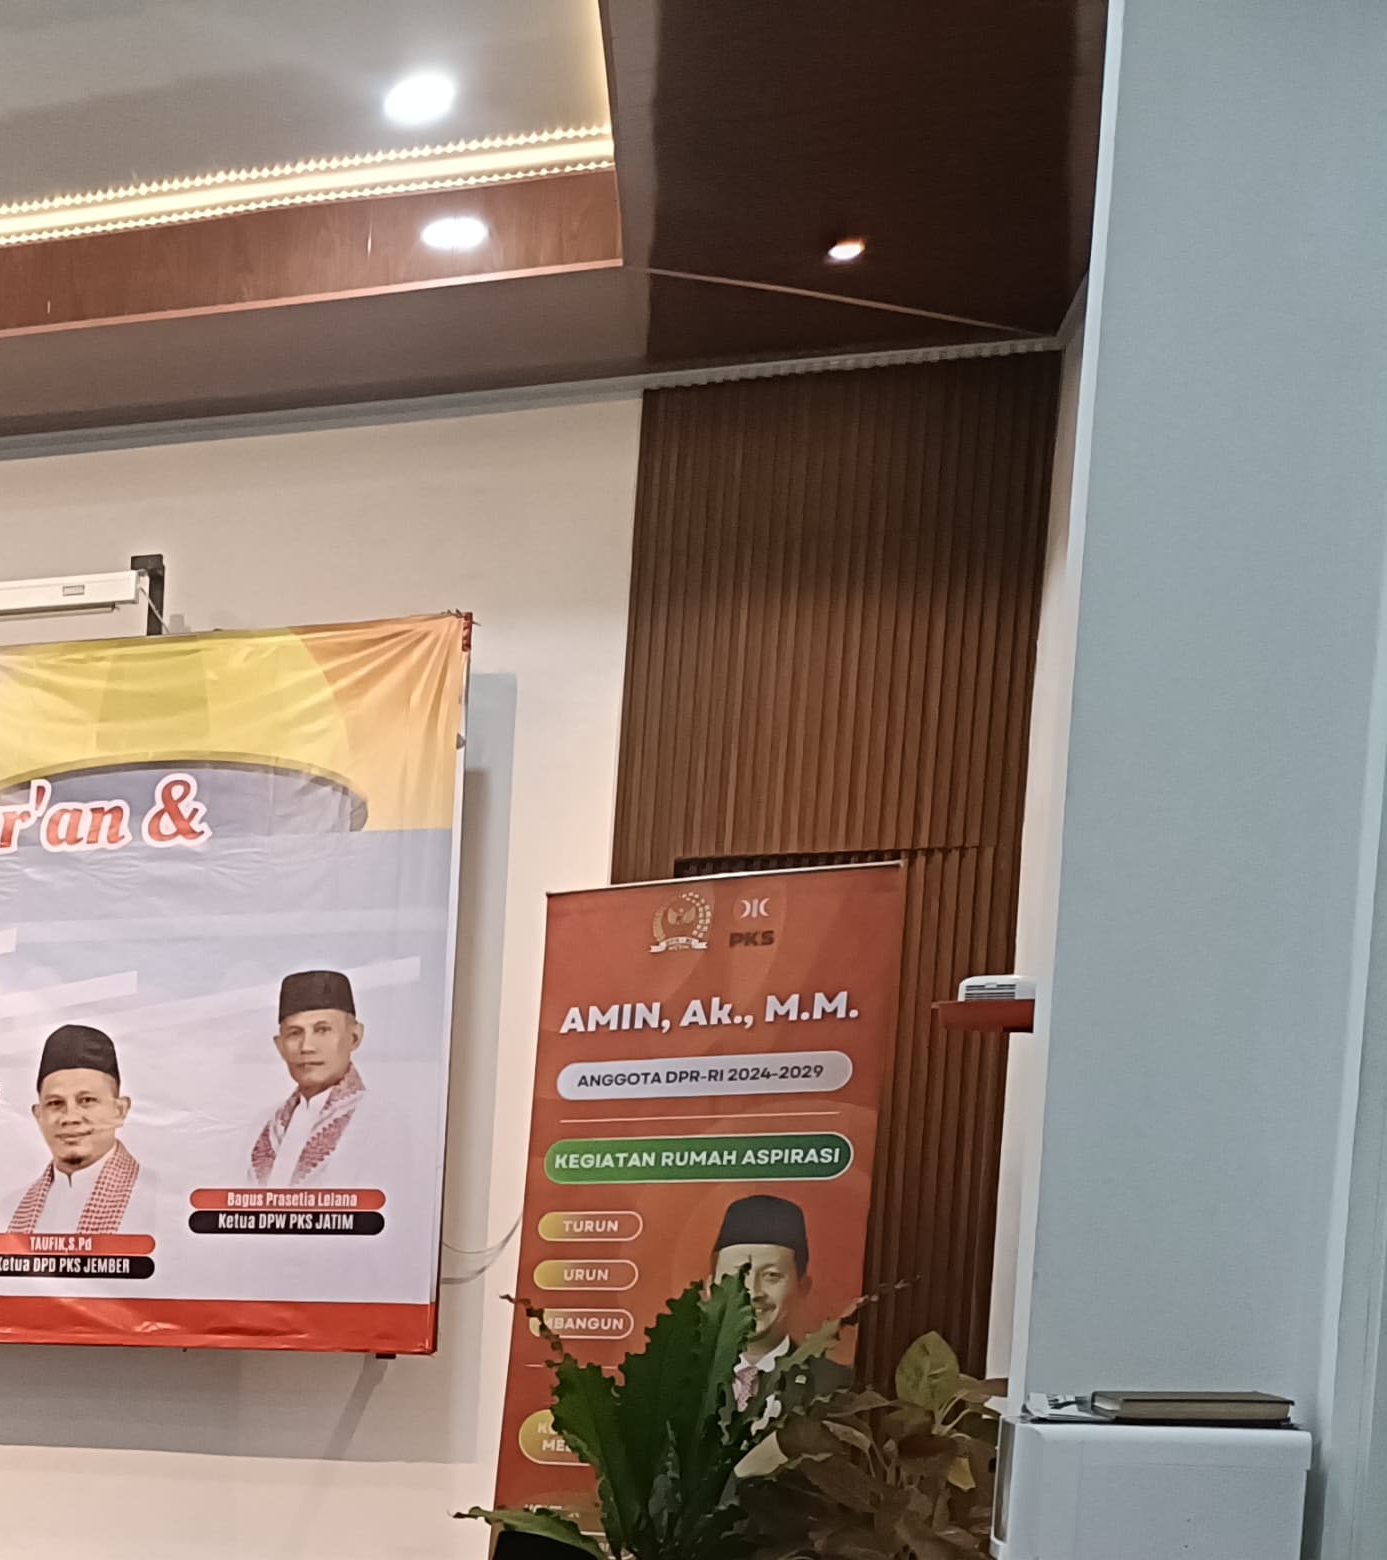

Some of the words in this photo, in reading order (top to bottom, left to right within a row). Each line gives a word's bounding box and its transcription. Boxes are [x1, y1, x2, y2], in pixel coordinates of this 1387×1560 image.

[148, 779, 205, 842] &
[729, 930, 775, 947] PKS
[559, 1001, 671, 1034] AMIN,
[679, 996, 754, 1029] Ak.,
[764, 991, 859, 1022] M.M.
[577, 1071, 662, 1087] ANGGOTA
[666, 1068, 724, 1084] DPR-RI
[727, 1065, 824, 1081] 2024-2029
[554, 1151, 655, 1169] KEGIATAN
[662, 1149, 736, 1167] RUMAH
[741, 1148, 840, 1165] ASPIRASI
[227, 1192, 263, 1208] Bagus
[266, 1192, 314, 1207] Prasetia
[219, 1213, 255, 1229] Ketua
[259, 1214, 287, 1229] DPW
[289, 1214, 312, 1229] PKS
[315, 1214, 354, 1230] JATIM
[563, 1220, 619, 1233] TURUN
[33, 1257, 56, 1272] DPD
[59, 1258, 81, 1273] PKS
[83, 1258, 130, 1273] JEMBER
[563, 1269, 609, 1281] URUN
